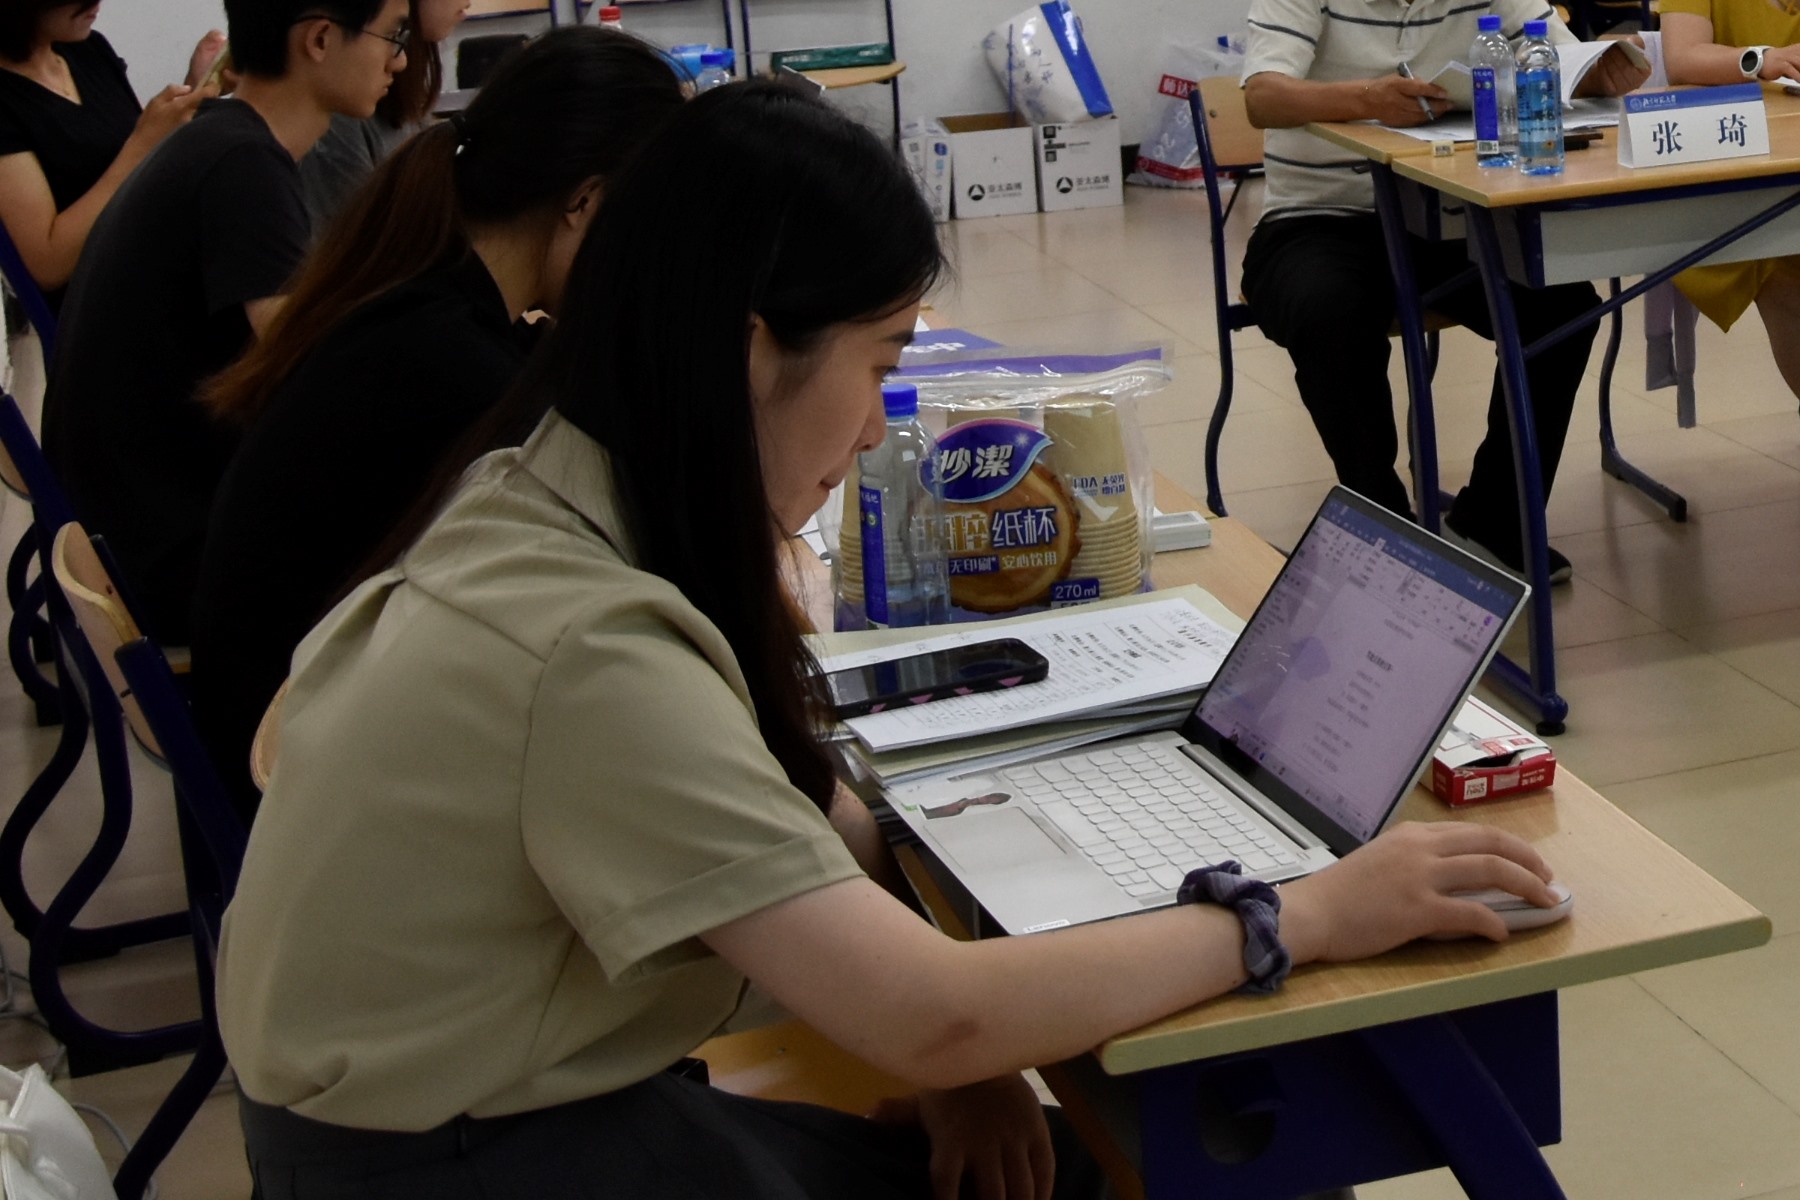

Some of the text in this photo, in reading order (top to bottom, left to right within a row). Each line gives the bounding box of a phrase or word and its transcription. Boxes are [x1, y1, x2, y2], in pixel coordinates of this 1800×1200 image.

[1651, 113, 1748, 155] 张琦
[1001, 551, 1057, 570] 安心饮用
[1055, 584, 1097, 599] 270 ml
